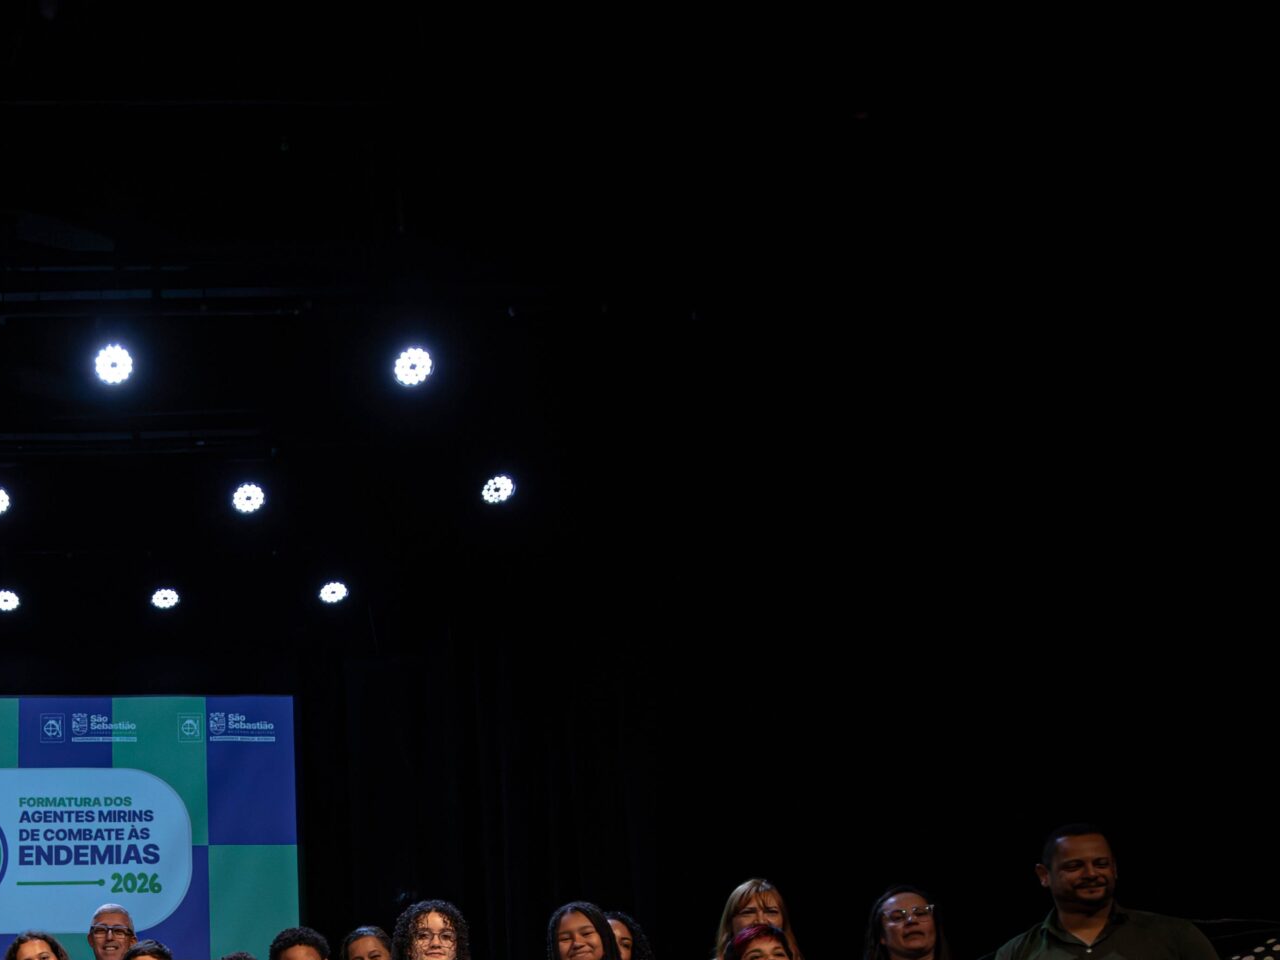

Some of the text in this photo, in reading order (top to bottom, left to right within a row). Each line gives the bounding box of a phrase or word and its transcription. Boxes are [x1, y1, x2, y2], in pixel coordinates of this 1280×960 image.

[90, 714, 108, 723] São
[228, 713, 246, 721] São
[90, 721, 136, 730] Sebastião
[228, 720, 274, 730] Sebastião
[19, 796, 132, 807] FORMATURA DOS
[19, 810, 154, 823] AGENTES MIRINS
[19, 825, 150, 841] DE COMBATE ÀS
[18, 844, 160, 866] ENDEMIAS
[111, 872, 162, 894] 2026
